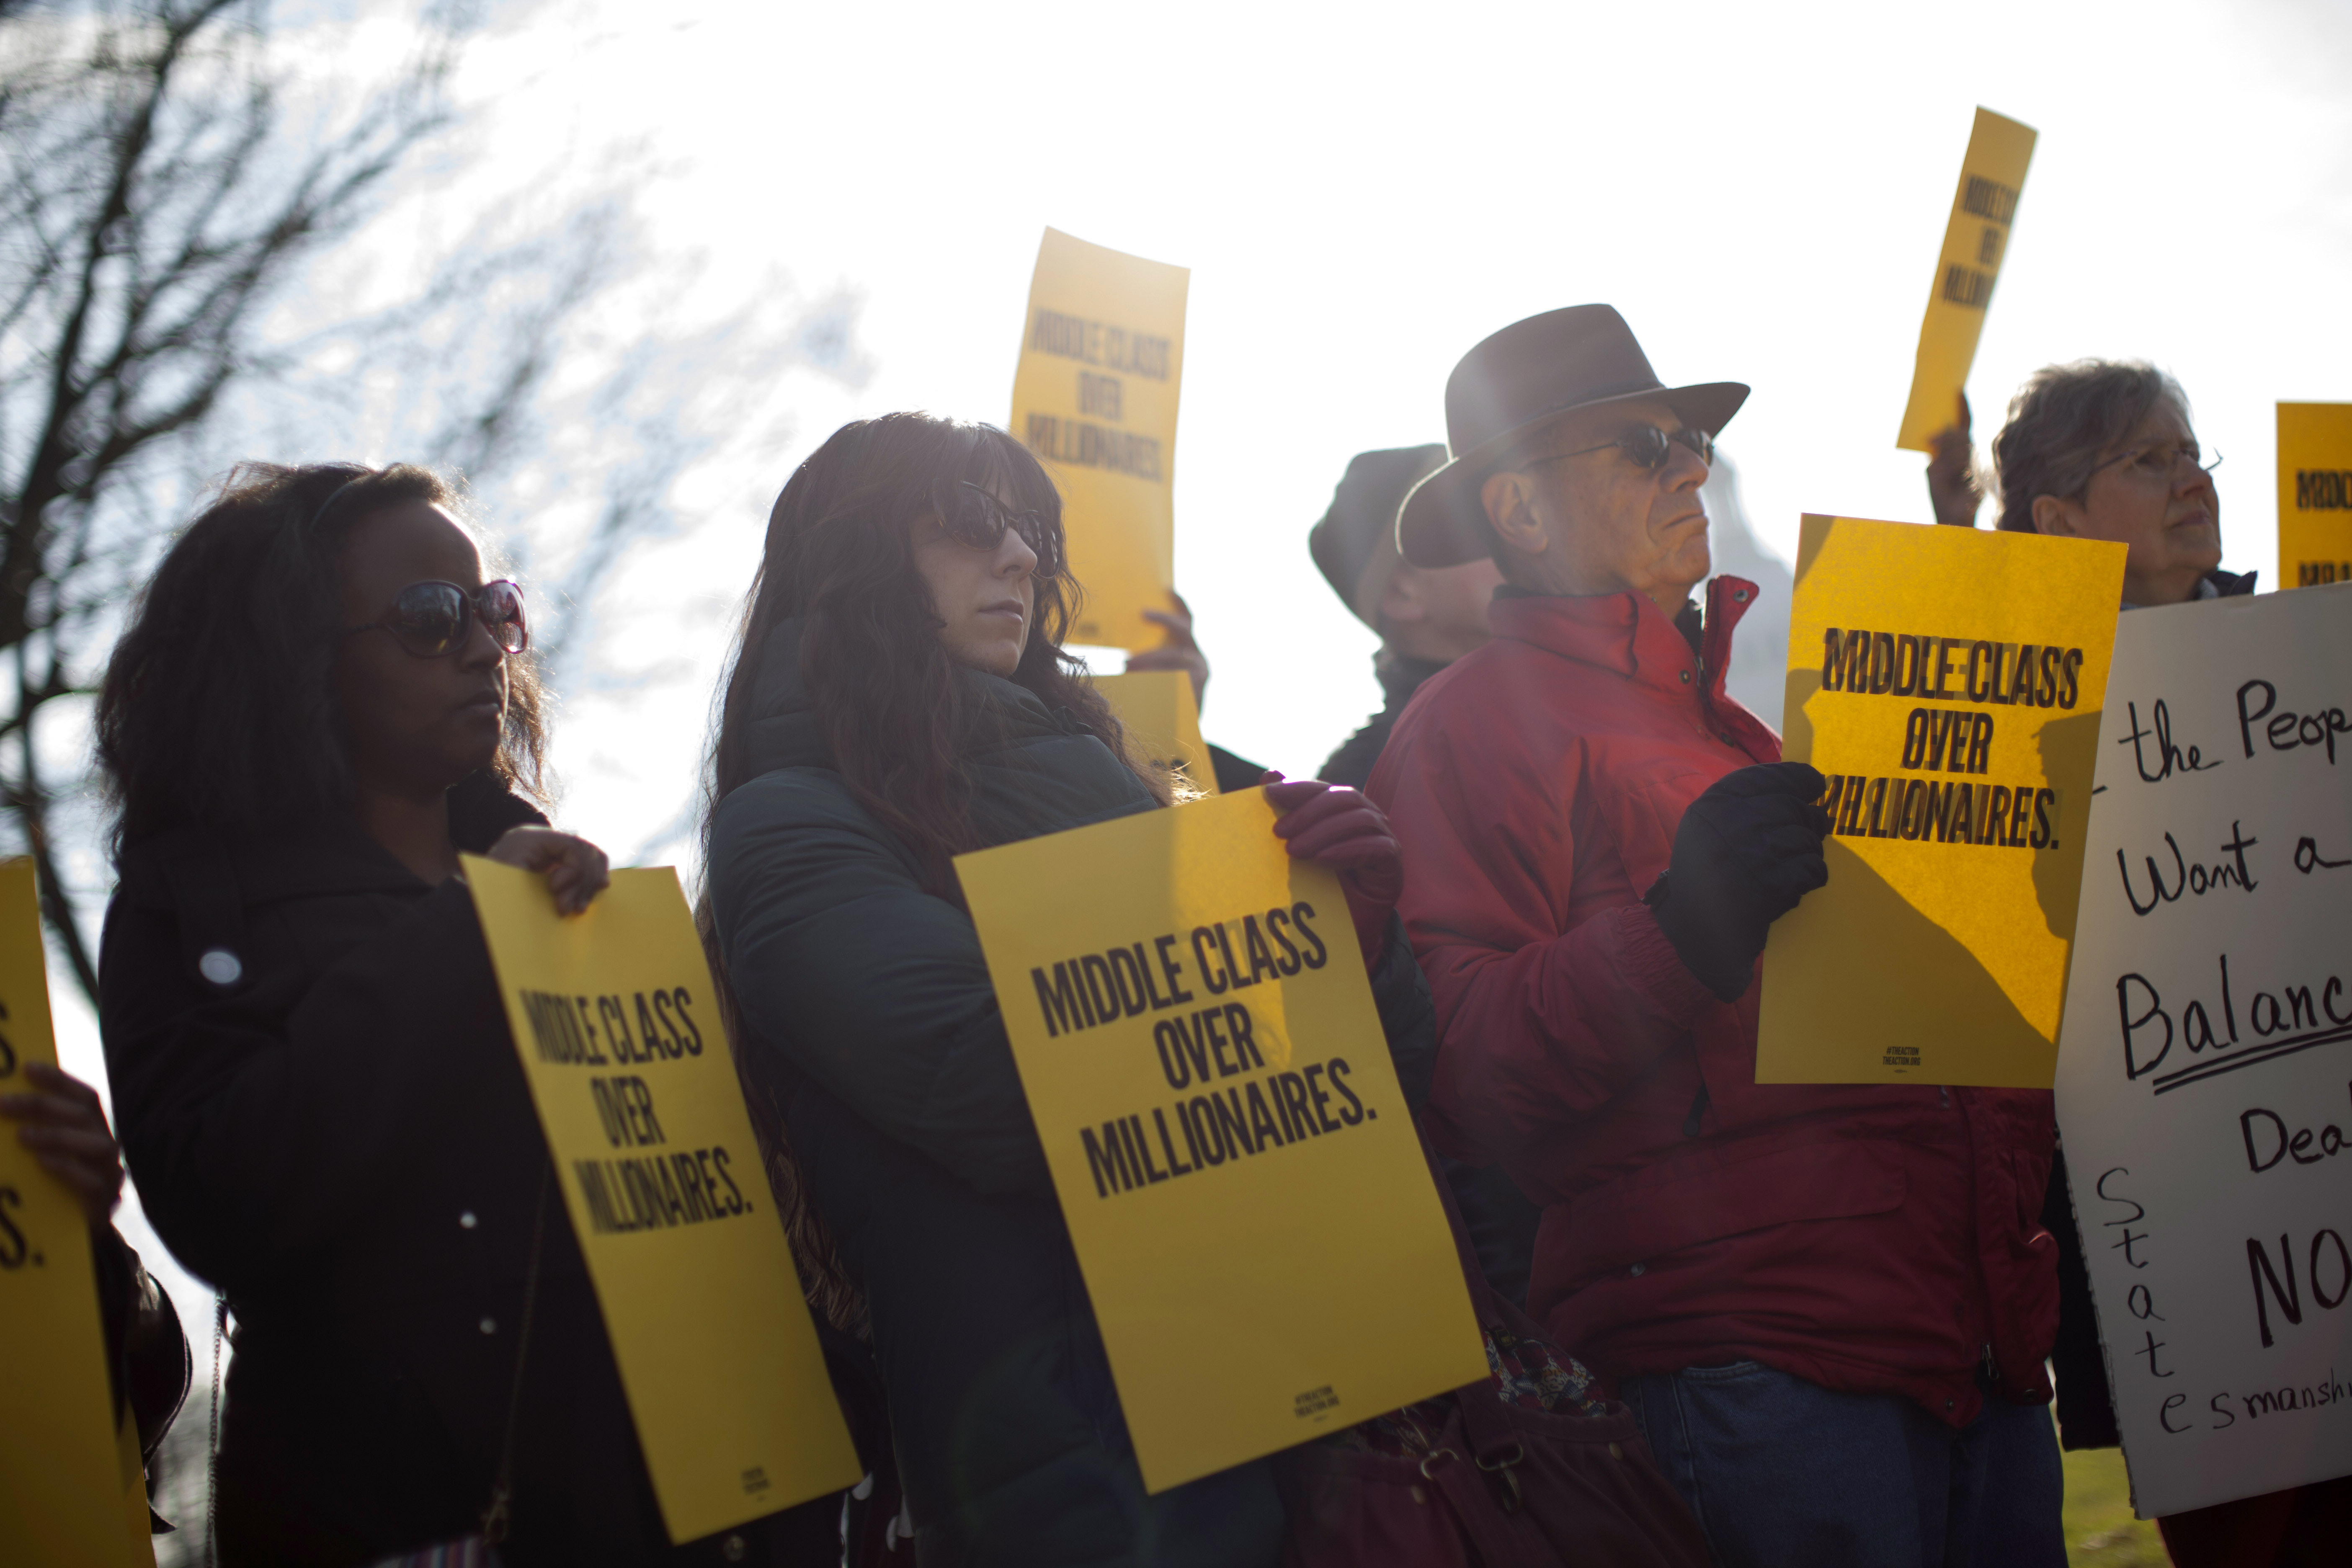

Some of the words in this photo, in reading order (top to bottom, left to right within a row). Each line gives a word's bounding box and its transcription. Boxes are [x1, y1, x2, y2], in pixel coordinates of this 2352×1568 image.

[1822, 627, 1962, 700] MIDDLE
[1967, 640, 2084, 710] CLASS
[1901, 707, 1994, 775] OVER
[2118, 699, 2224, 782] the
[2117, 820, 2259, 916] Want
[2294, 836, 2352, 874] a
[1030, 933, 1194, 1039] MIDDLE
[1191, 901, 1328, 995] CLASS
[596, 986, 704, 1066] CLASS
[1153, 1002, 1265, 1091] OVER
[1883, 1056, 1921, 1066] THEACTION.ORG
[590, 1075, 667, 1149] OVER
[1079, 1057, 1378, 1199] MILLIONAIRES.
